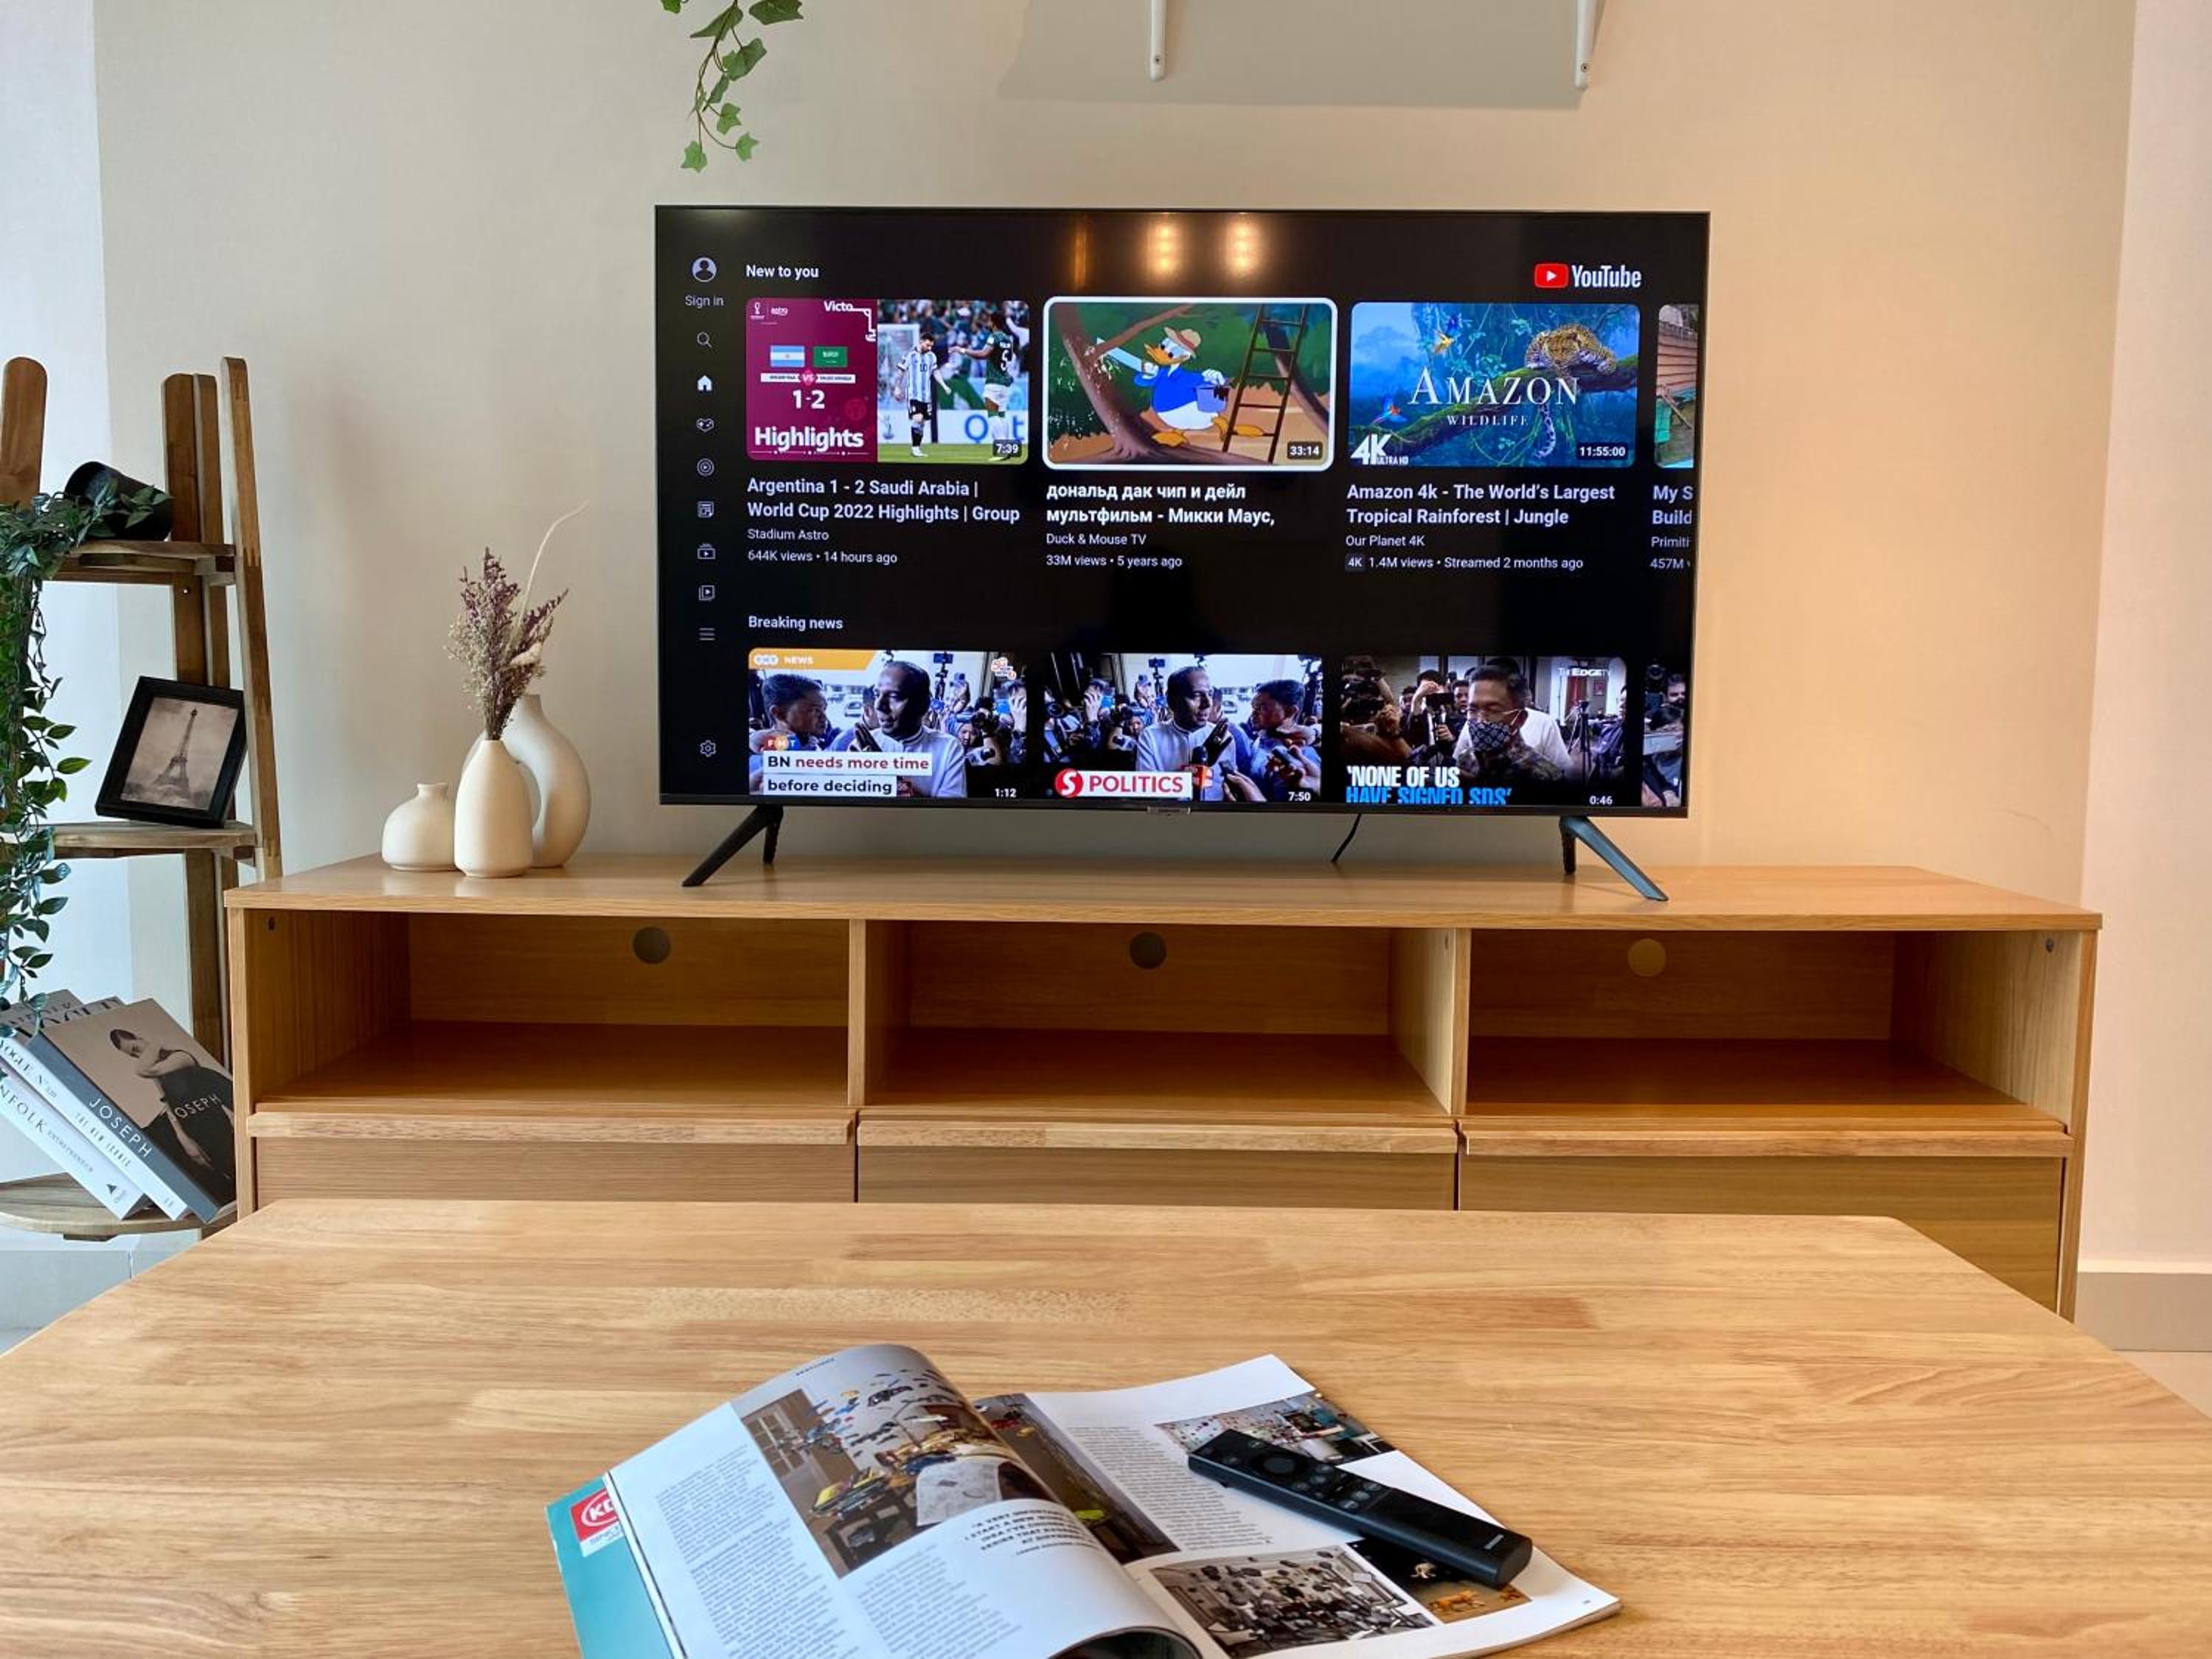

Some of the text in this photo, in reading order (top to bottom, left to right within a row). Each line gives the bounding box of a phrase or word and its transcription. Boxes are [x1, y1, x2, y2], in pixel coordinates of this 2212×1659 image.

[746, 265, 819, 280] New to you
[1571, 265, 1641, 288] YouTube
[685, 296, 723, 308] Sign in
[1408, 366, 1580, 405] AMAZON
[1447, 415, 1528, 425] WILDLIFE
[754, 427, 864, 452] Highlights
[996, 444, 1018, 453] 7:39
[1290, 445, 1319, 456] 33:14
[1350, 434, 1392, 465] 4K
[1579, 447, 1626, 456] 11:55:00
[747, 478, 825, 495] Argentina
[830, 480, 838, 493] 1
[855, 480, 865, 494] 2
[869, 480, 914, 495] Saudi
[918, 481, 970, 495] Arabia
[1046, 484, 1245, 501] дональд дак чип и дейл
[1347, 484, 1413, 499] Amazon
[1417, 484, 1437, 499] 4k
[1453, 484, 1484, 499] The
[1488, 484, 1549, 499] World’s
[1554, 485, 1615, 503] Largest
[1653, 485, 1678, 504] My
[747, 502, 793, 516] World
[799, 504, 829, 521] Cup
[834, 504, 874, 518] 2022
[878, 506, 959, 522] Highlights
[973, 506, 1020, 523] Group
[1046, 507, 1152, 525] мультфильм
[1169, 509, 1223, 523] Микки
[1228, 509, 1275, 526] Маус,
[1346, 509, 1412, 526] Tropical
[1416, 509, 1500, 524] Rainforest
[1513, 509, 1569, 526] Jungle
[748, 529, 829, 540] Stadium Astro
[1046, 534, 1147, 545] Duck & Mouse TV
[1346, 535, 1425, 546] Our Planet 4K
[748, 550, 777, 561] 644K
[780, 550, 813, 561] views
[824, 551, 838, 562] 14
[841, 551, 872, 563] hours
[875, 554, 897, 565] ago
[1046, 555, 1071, 566] 33M
[1074, 555, 1107, 566] views
[1118, 556, 1124, 566] 5
[1127, 557, 1158, 568] years
[1161, 559, 1182, 569] ago
[1348, 558, 1363, 568] 4K
[1368, 557, 1397, 568] 1.4M
[1401, 557, 1433, 568] views
[1444, 557, 1500, 569] Streamed
[1503, 558, 1511, 568] 2
[1514, 558, 1558, 569] months
[1561, 560, 1584, 572] ago
[1649, 557, 1684, 569] 457M
[748, 616, 843, 631] Breaking news
[784, 655, 813, 664] NEWS
[768, 756, 929, 769] BN needs more time
[1090, 775, 1183, 793] POLITICS
[1406, 767, 1429, 787] OF
[1435, 767, 1460, 787] US
[768, 780, 817, 792] before
[824, 780, 891, 794] deciding
[995, 788, 1017, 798] 1:12
[1288, 791, 1311, 801] 7:50
[1346, 787, 1391, 803] HAVE
[1397, 787, 1463, 804] SIGNED
[1590, 796, 1613, 804] 0:46
[89, 1097, 153, 1158] JOSEPH
